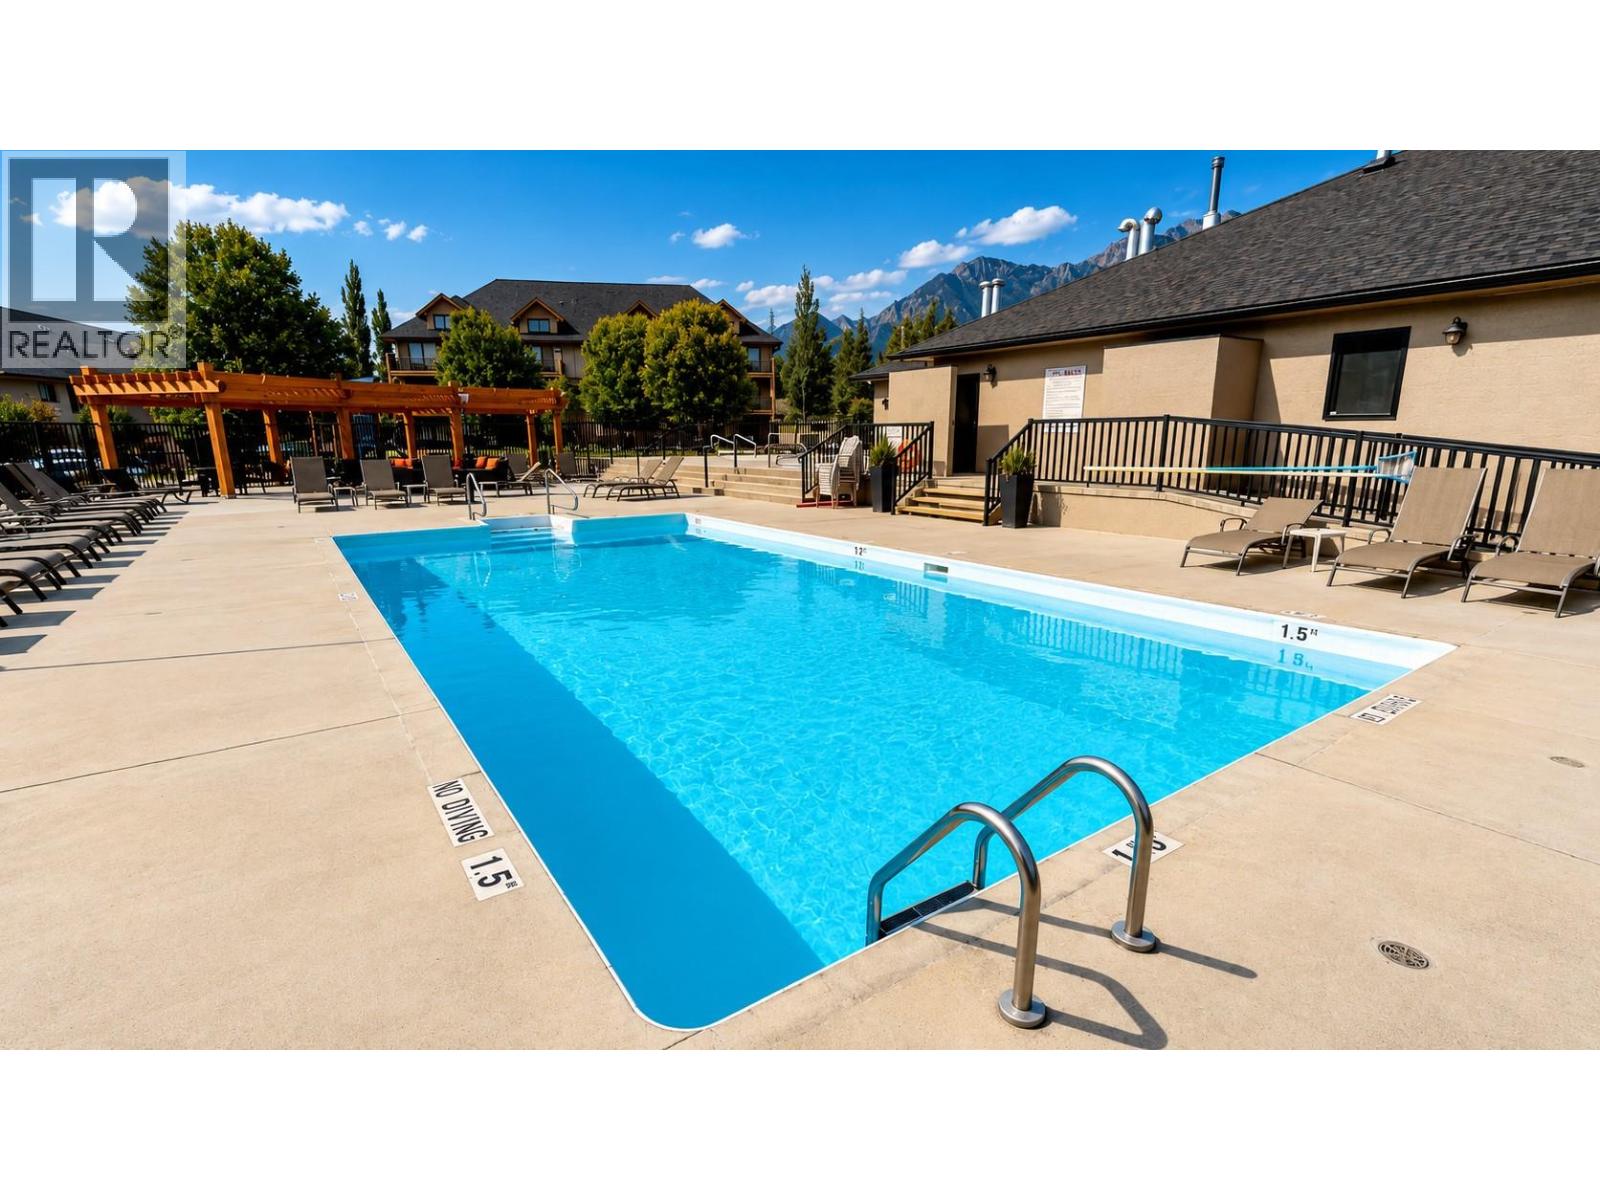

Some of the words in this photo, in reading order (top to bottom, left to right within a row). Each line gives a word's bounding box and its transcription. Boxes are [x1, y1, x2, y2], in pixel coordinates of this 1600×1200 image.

[1281, 623, 1308, 641] 1.5
[432, 780, 463, 797] NO
[441, 798, 489, 843] DIVING
[470, 856, 513, 887] 1.5
